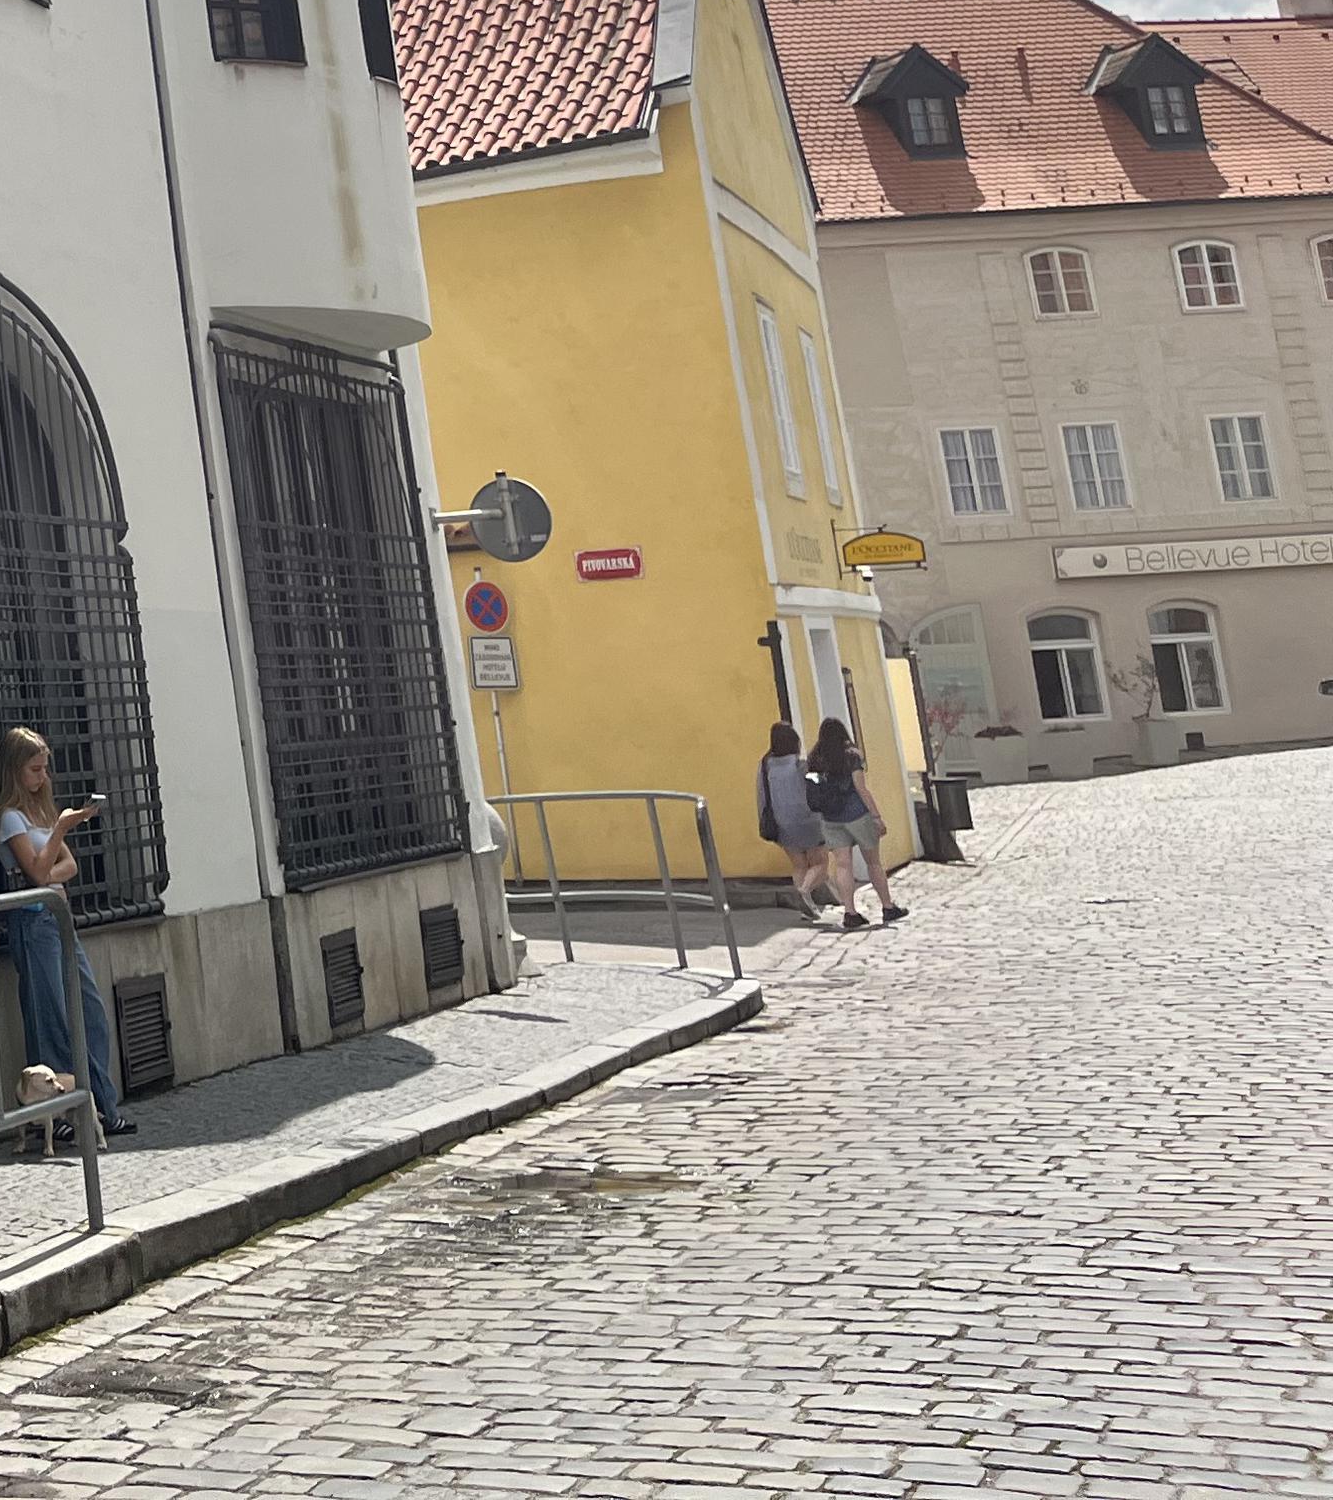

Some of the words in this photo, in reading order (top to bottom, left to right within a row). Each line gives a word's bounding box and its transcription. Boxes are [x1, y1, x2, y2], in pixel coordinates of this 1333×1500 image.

[581, 552, 636, 572] PIVOVARSKÁ
[1124, 545, 1251, 573] Bellevue
[1259, 536, 1333, 564] Hotel
